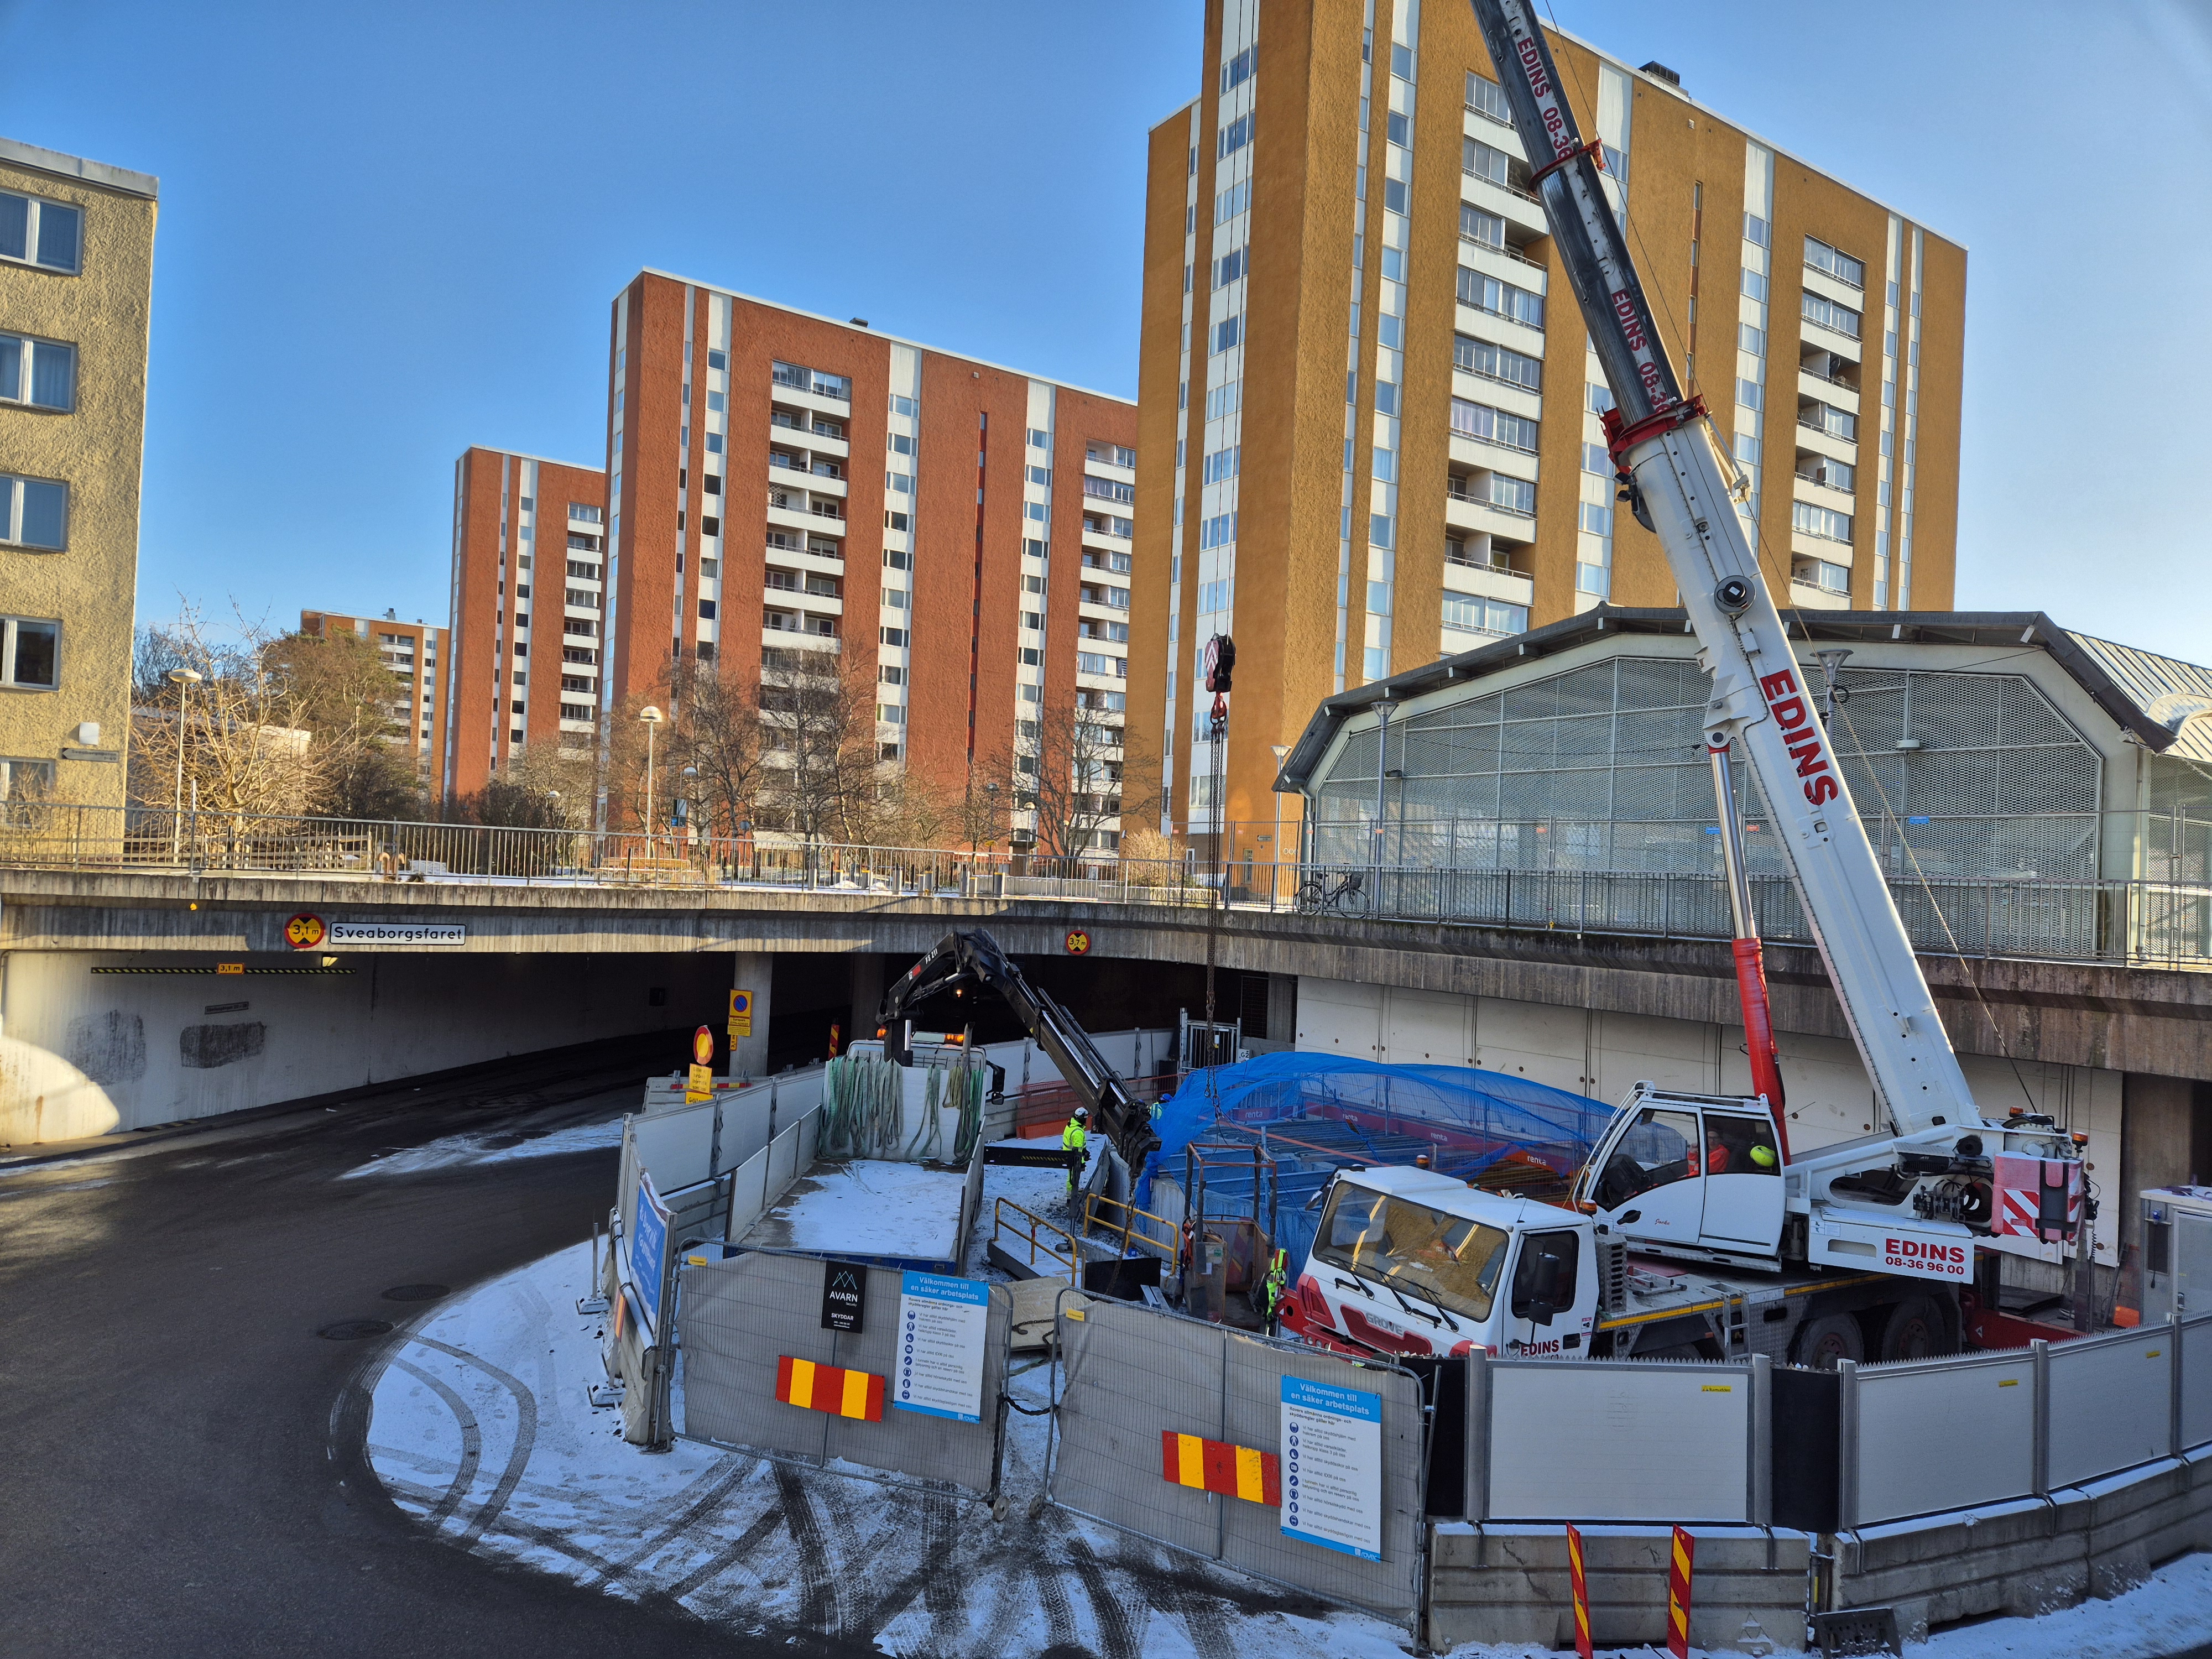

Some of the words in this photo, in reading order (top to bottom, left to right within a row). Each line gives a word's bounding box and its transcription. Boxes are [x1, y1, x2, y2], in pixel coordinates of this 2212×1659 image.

[1517, 37, 1551, 97] EDINS
[1611, 288, 1647, 351] EDINS
[1760, 669, 1838, 806] EDINS
[293, 925, 309, 936] 3,1
[334, 926, 462, 941] Sveaborgsfaret
[1069, 938, 1079, 946] 3,7
[1343, 1113, 1358, 1121] renta
[1431, 1132, 1448, 1141] renta
[1527, 1155, 1546, 1166] renta
[1886, 1238, 1964, 1263] EDINS
[1886, 1256, 1924, 1269] 08-36
[1927, 1262, 1944, 1272] 96
[1948, 1265, 1964, 1275] 00
[919, 1277, 958, 1288] Välkommen
[830, 1291, 858, 1302] AVARN
[921, 1285, 939, 1294] säker
[941, 1290, 979, 1300] arbetsplats
[1366, 1313, 1402, 1335] GROVE
[1521, 1339, 1559, 1356] EDINS
[1300, 1383, 1345, 1400] Välkommen
[1347, 1394, 1357, 1402] till
[1302, 1395, 1323, 1405] säker
[1326, 1400, 1369, 1415] arbetsplats
